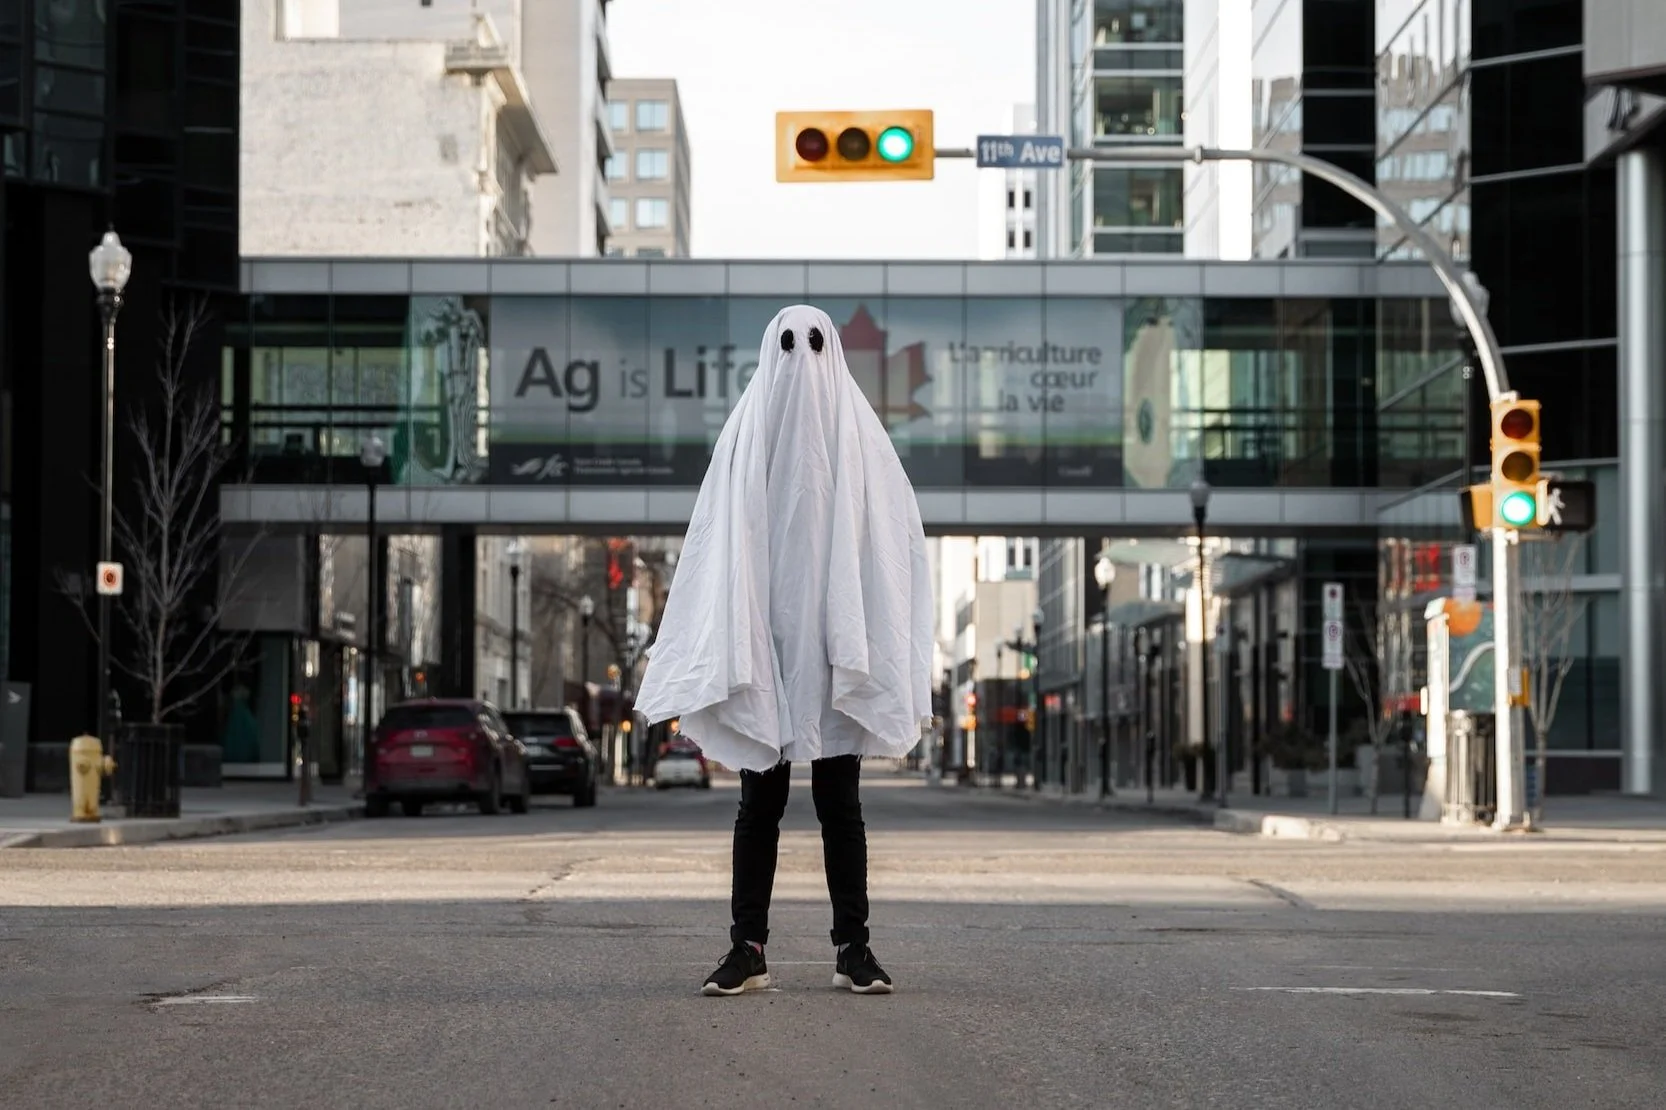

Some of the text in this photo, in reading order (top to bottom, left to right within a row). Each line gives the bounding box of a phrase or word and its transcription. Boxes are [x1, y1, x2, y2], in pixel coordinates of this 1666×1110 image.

[981, 140, 1061, 163] 11th Ave
[514, 346, 600, 412] Ag
[620, 359, 648, 398] is
